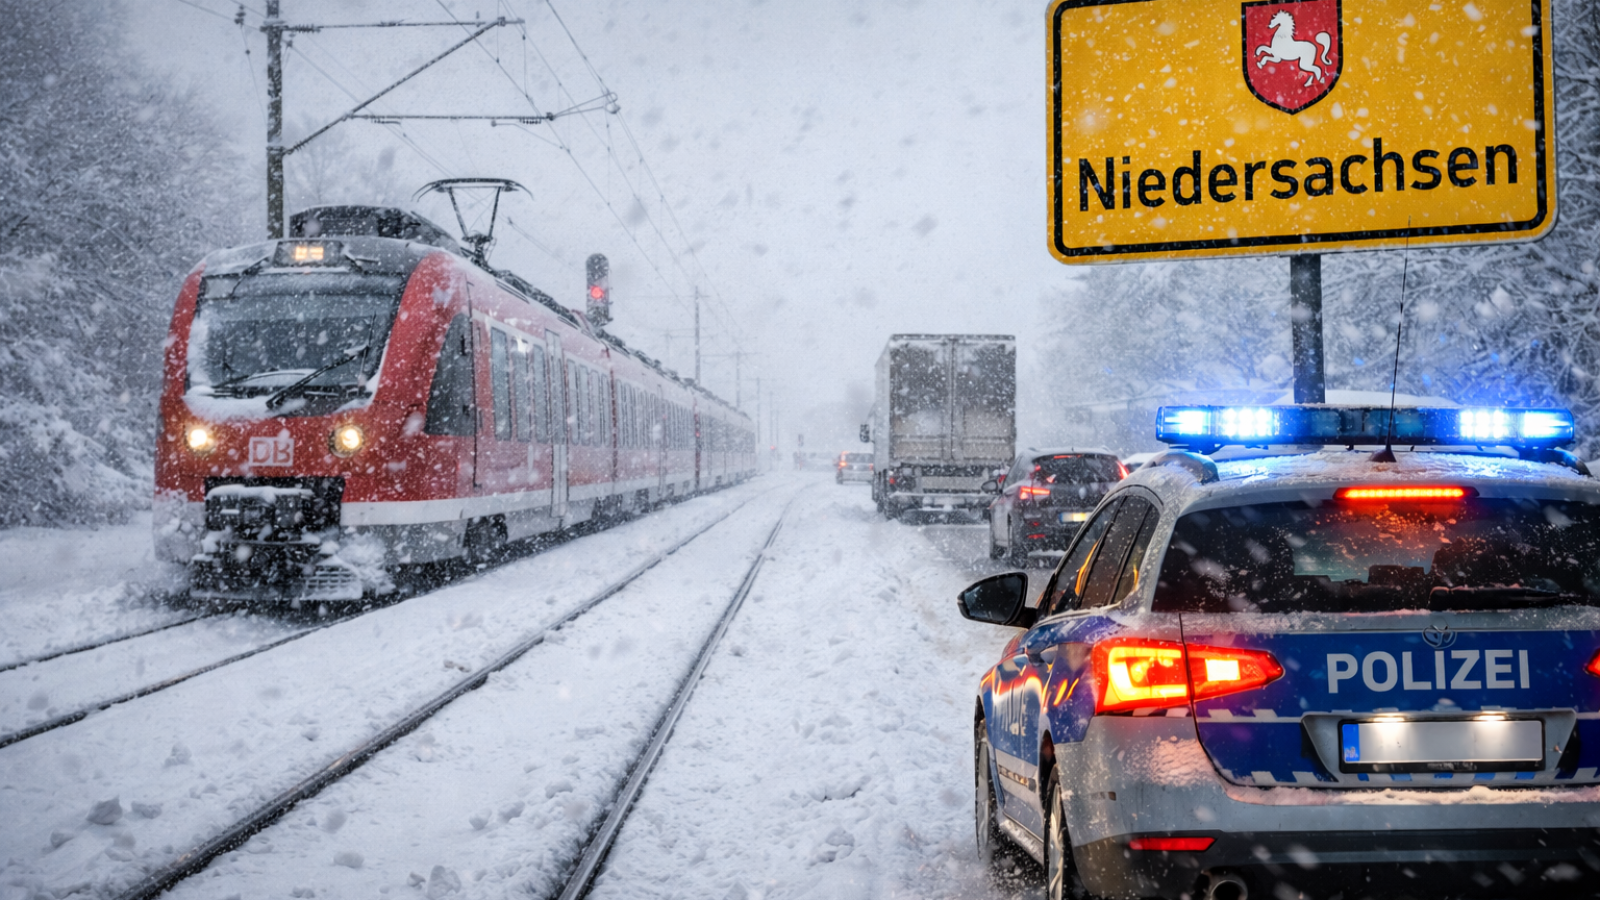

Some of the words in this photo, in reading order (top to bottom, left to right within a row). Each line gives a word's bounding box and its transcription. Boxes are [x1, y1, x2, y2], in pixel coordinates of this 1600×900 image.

[1079, 137, 1518, 212] Niedersachsen
[252, 440, 291, 464] DB
[1326, 649, 1530, 694] POLIZEI
